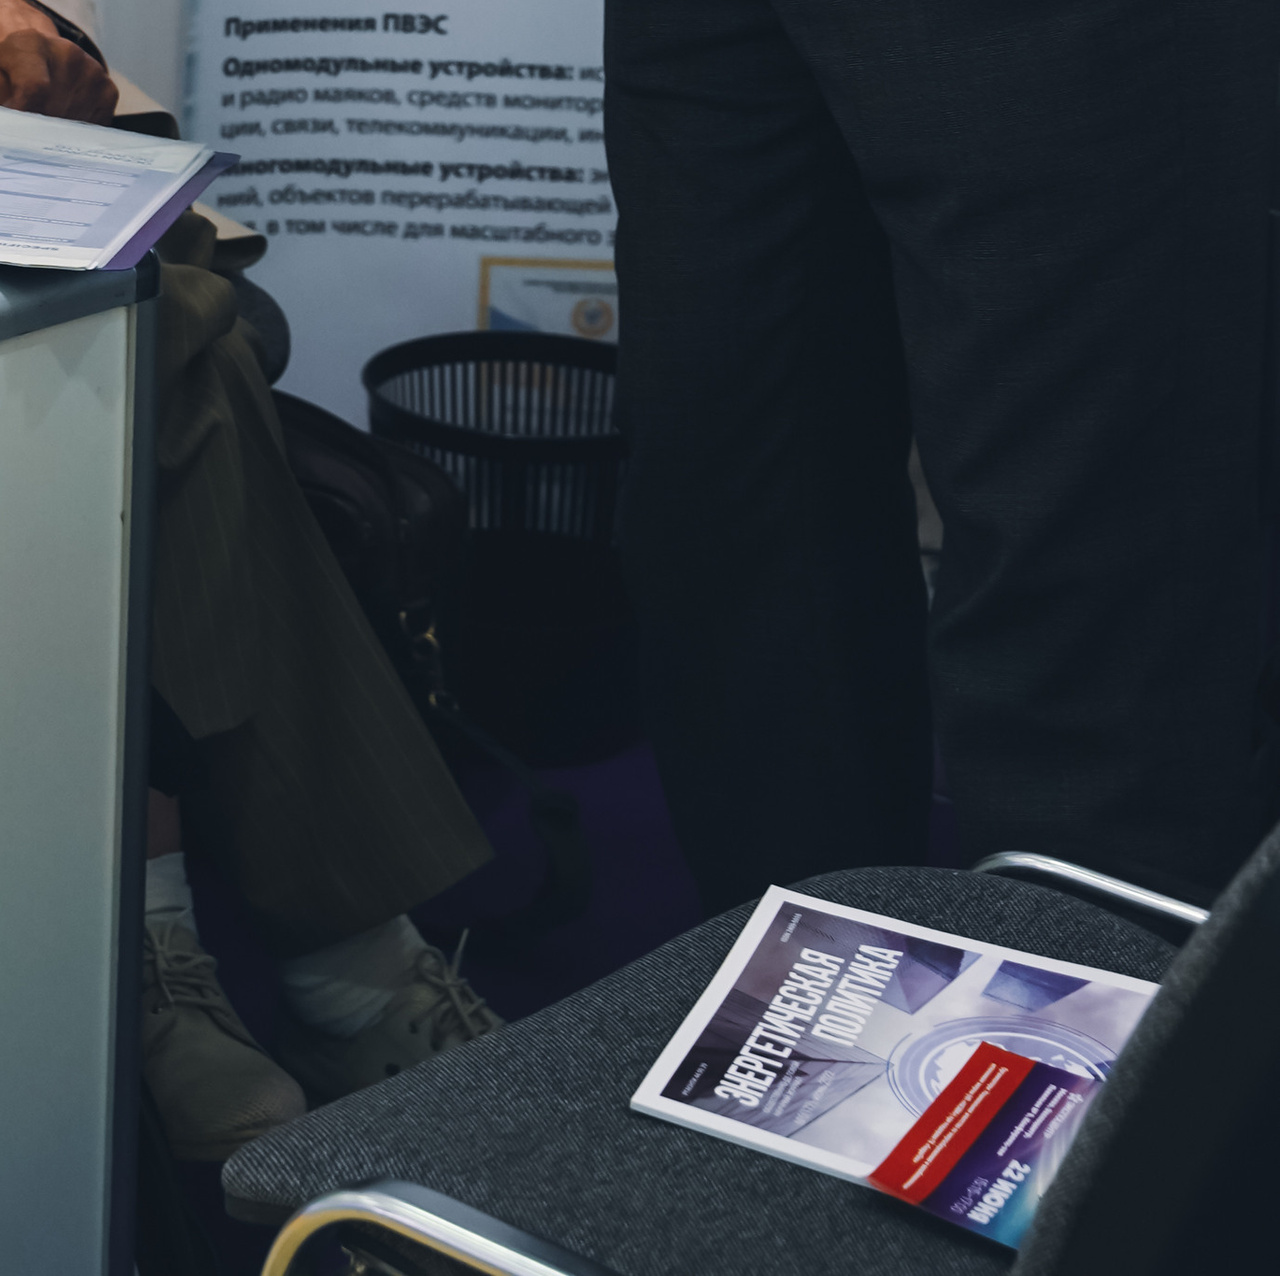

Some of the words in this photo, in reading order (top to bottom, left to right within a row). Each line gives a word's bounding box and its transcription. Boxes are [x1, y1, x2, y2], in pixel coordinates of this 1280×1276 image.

[224, 16, 376, 40] Применения
[382, 13, 449, 35] ПВЭС
[222, 56, 422, 78] Одномодульные
[429, 58, 574, 80] устройства:
[222, 92, 235, 108] и
[239, 89, 308, 110] радио
[314, 87, 401, 106] маяков,
[407, 88, 498, 111] средств
[220, 121, 266, 140] ции,
[271, 119, 340, 137] связи,
[346, 120, 573, 143] телекоммуникации,
[439, 161, 585, 183] устройства:
[268, 185, 375, 206] объектов
[381, 189, 612, 215] перерабатывающей
[266, 220, 279, 235] в
[285, 220, 326, 235] том
[331, 221, 399, 238] числе
[402, 223, 445, 240] для
[450, 224, 602, 245] масштабного
[811, 944, 904, 1046] ПОЛИТИКА
[714, 947, 846, 1108] ЭНЕРГЕТИЧЕСКАЯ
[1002, 1159, 1031, 1182] 22
[967, 1177, 1018, 1225] ИЮНЯ
